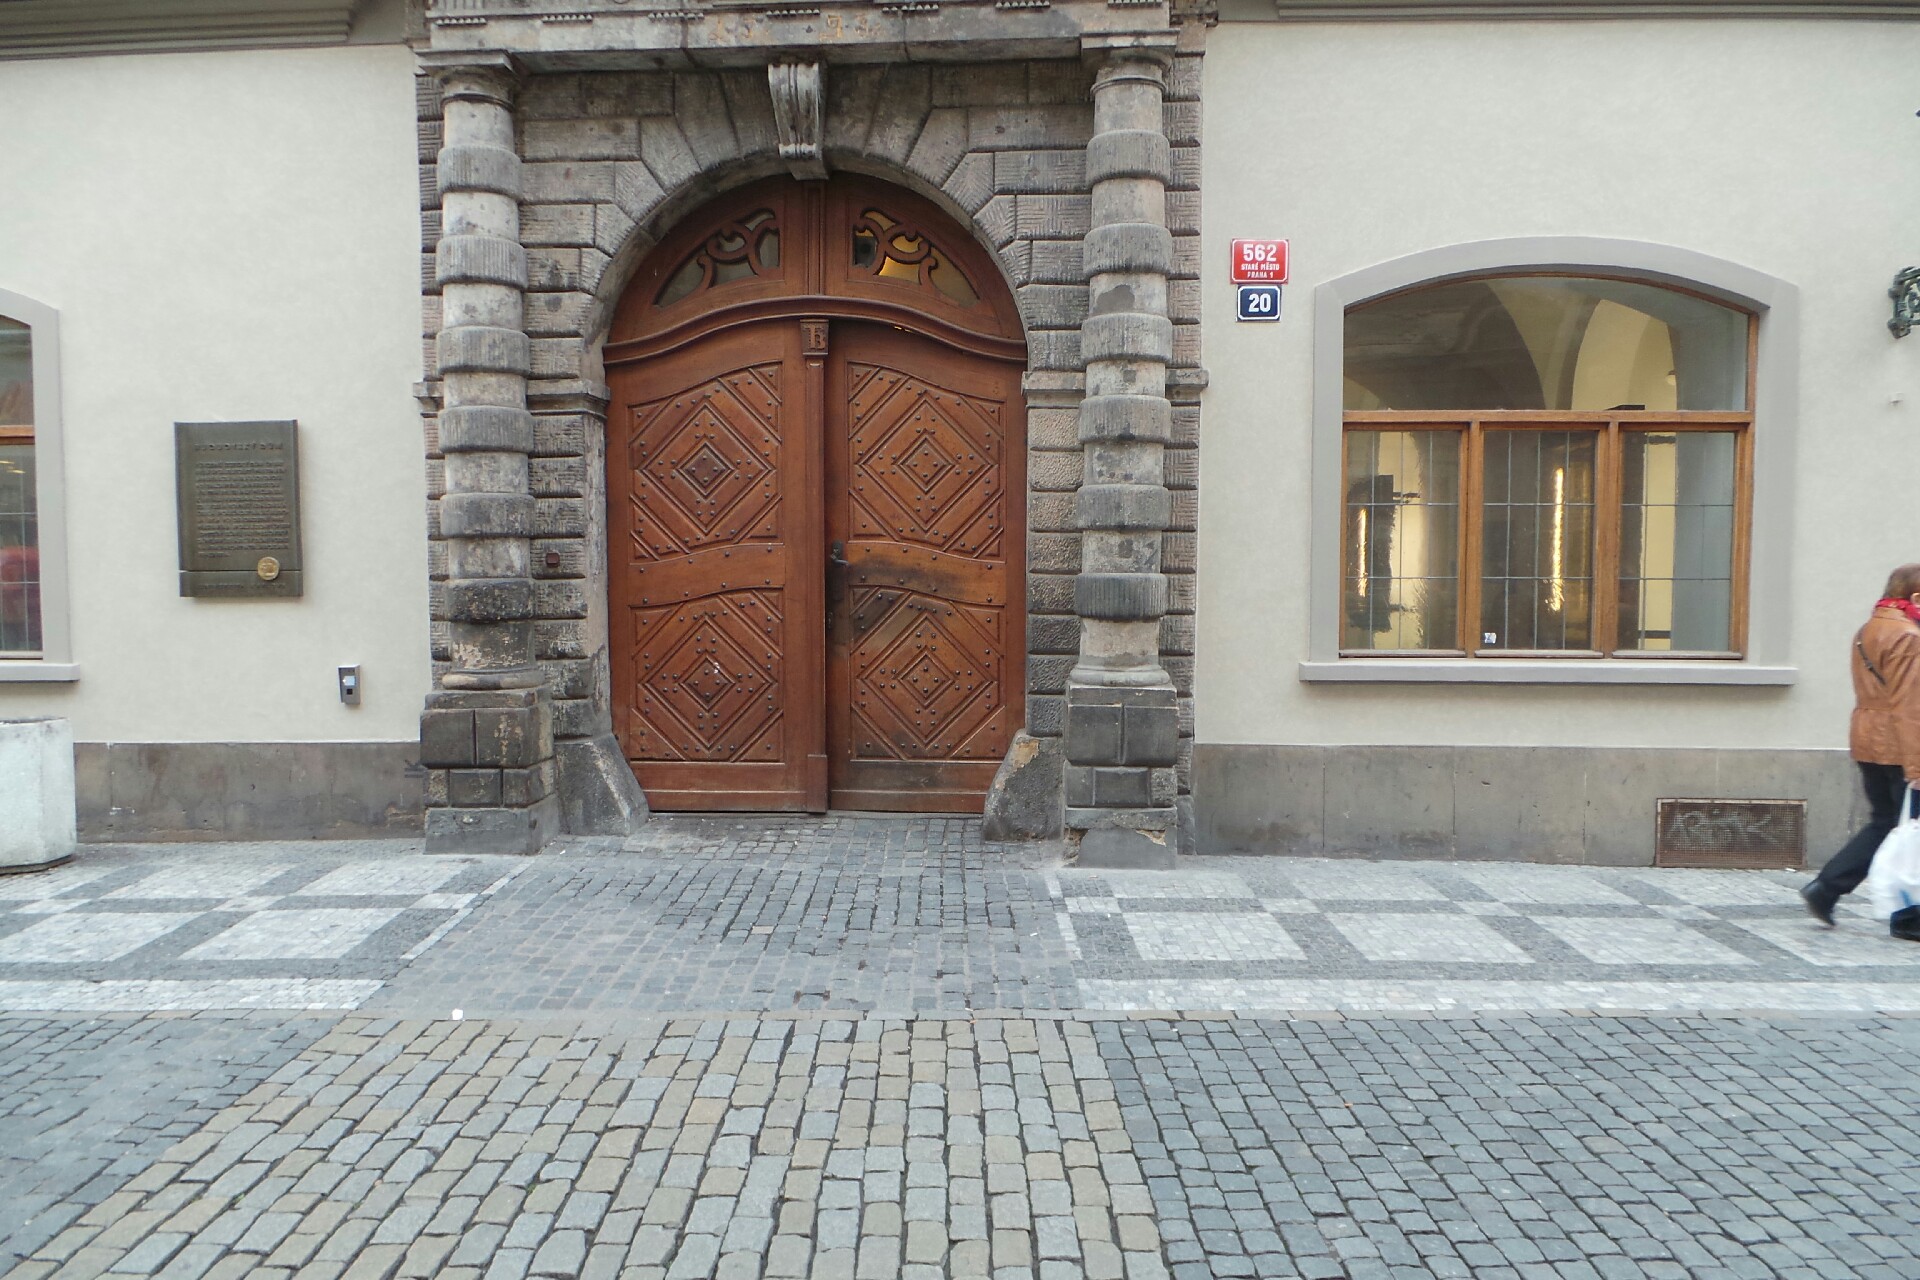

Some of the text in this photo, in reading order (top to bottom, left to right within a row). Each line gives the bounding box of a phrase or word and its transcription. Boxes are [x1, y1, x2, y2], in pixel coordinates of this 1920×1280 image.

[1243, 243, 1277, 262] 562
[1241, 262, 1280, 271] STARÉ MĚSTO
[1247, 271, 1274, 279] PRAHA 1
[1248, 293, 1271, 313] 20
